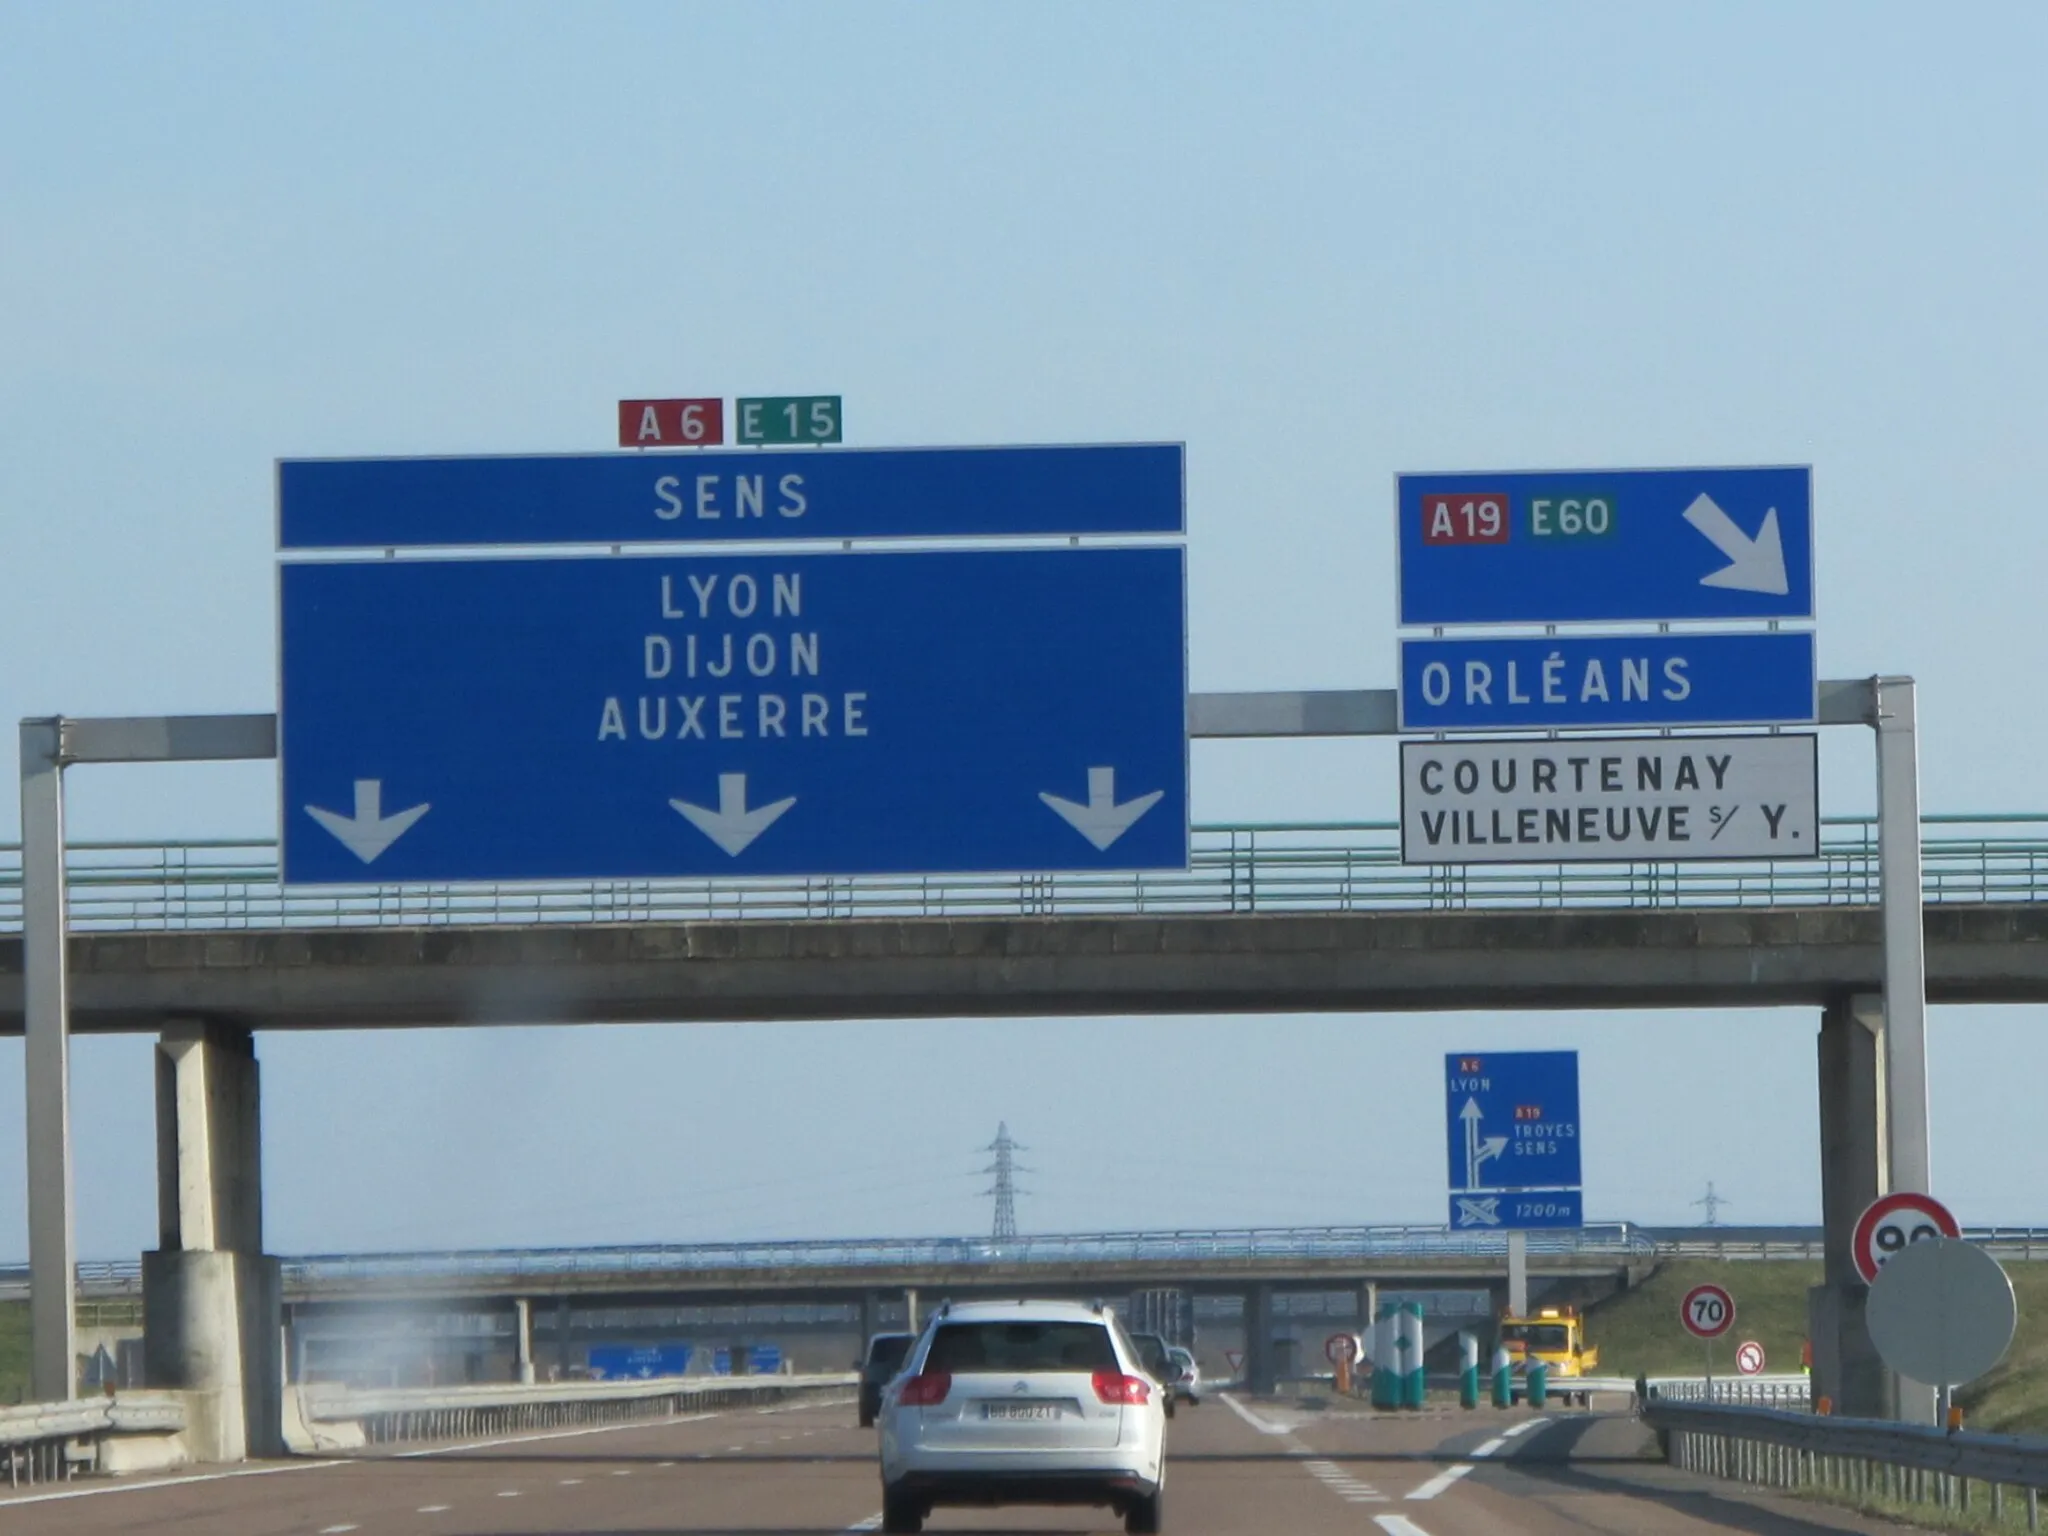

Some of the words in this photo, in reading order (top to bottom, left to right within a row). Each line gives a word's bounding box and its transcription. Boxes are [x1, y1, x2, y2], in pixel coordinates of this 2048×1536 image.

[638, 406, 661, 440] A
[681, 404, 705, 439] 6
[743, 404, 764, 438] E
[783, 402, 834, 438] 15
[654, 475, 806, 519] SENS
[1431, 500, 1501, 537] A19
[1532, 499, 1609, 535] E60
[661, 574, 800, 618] LYON
[645, 633, 818, 678] DIJON
[1421, 652, 1692, 706] ORLÉANS
[599, 693, 868, 740] AUXERRE
[1419, 755, 1732, 795] COURTENAY
[1420, 806, 1690, 845] VILLENEUVE
[1760, 804, 1800, 839] Y.
[1451, 1078, 1490, 1092] LYON
[1514, 1124, 1575, 1138] TROYES
[1514, 1141, 1557, 1155] SENS
[1694, 1299, 1723, 1322] 70
